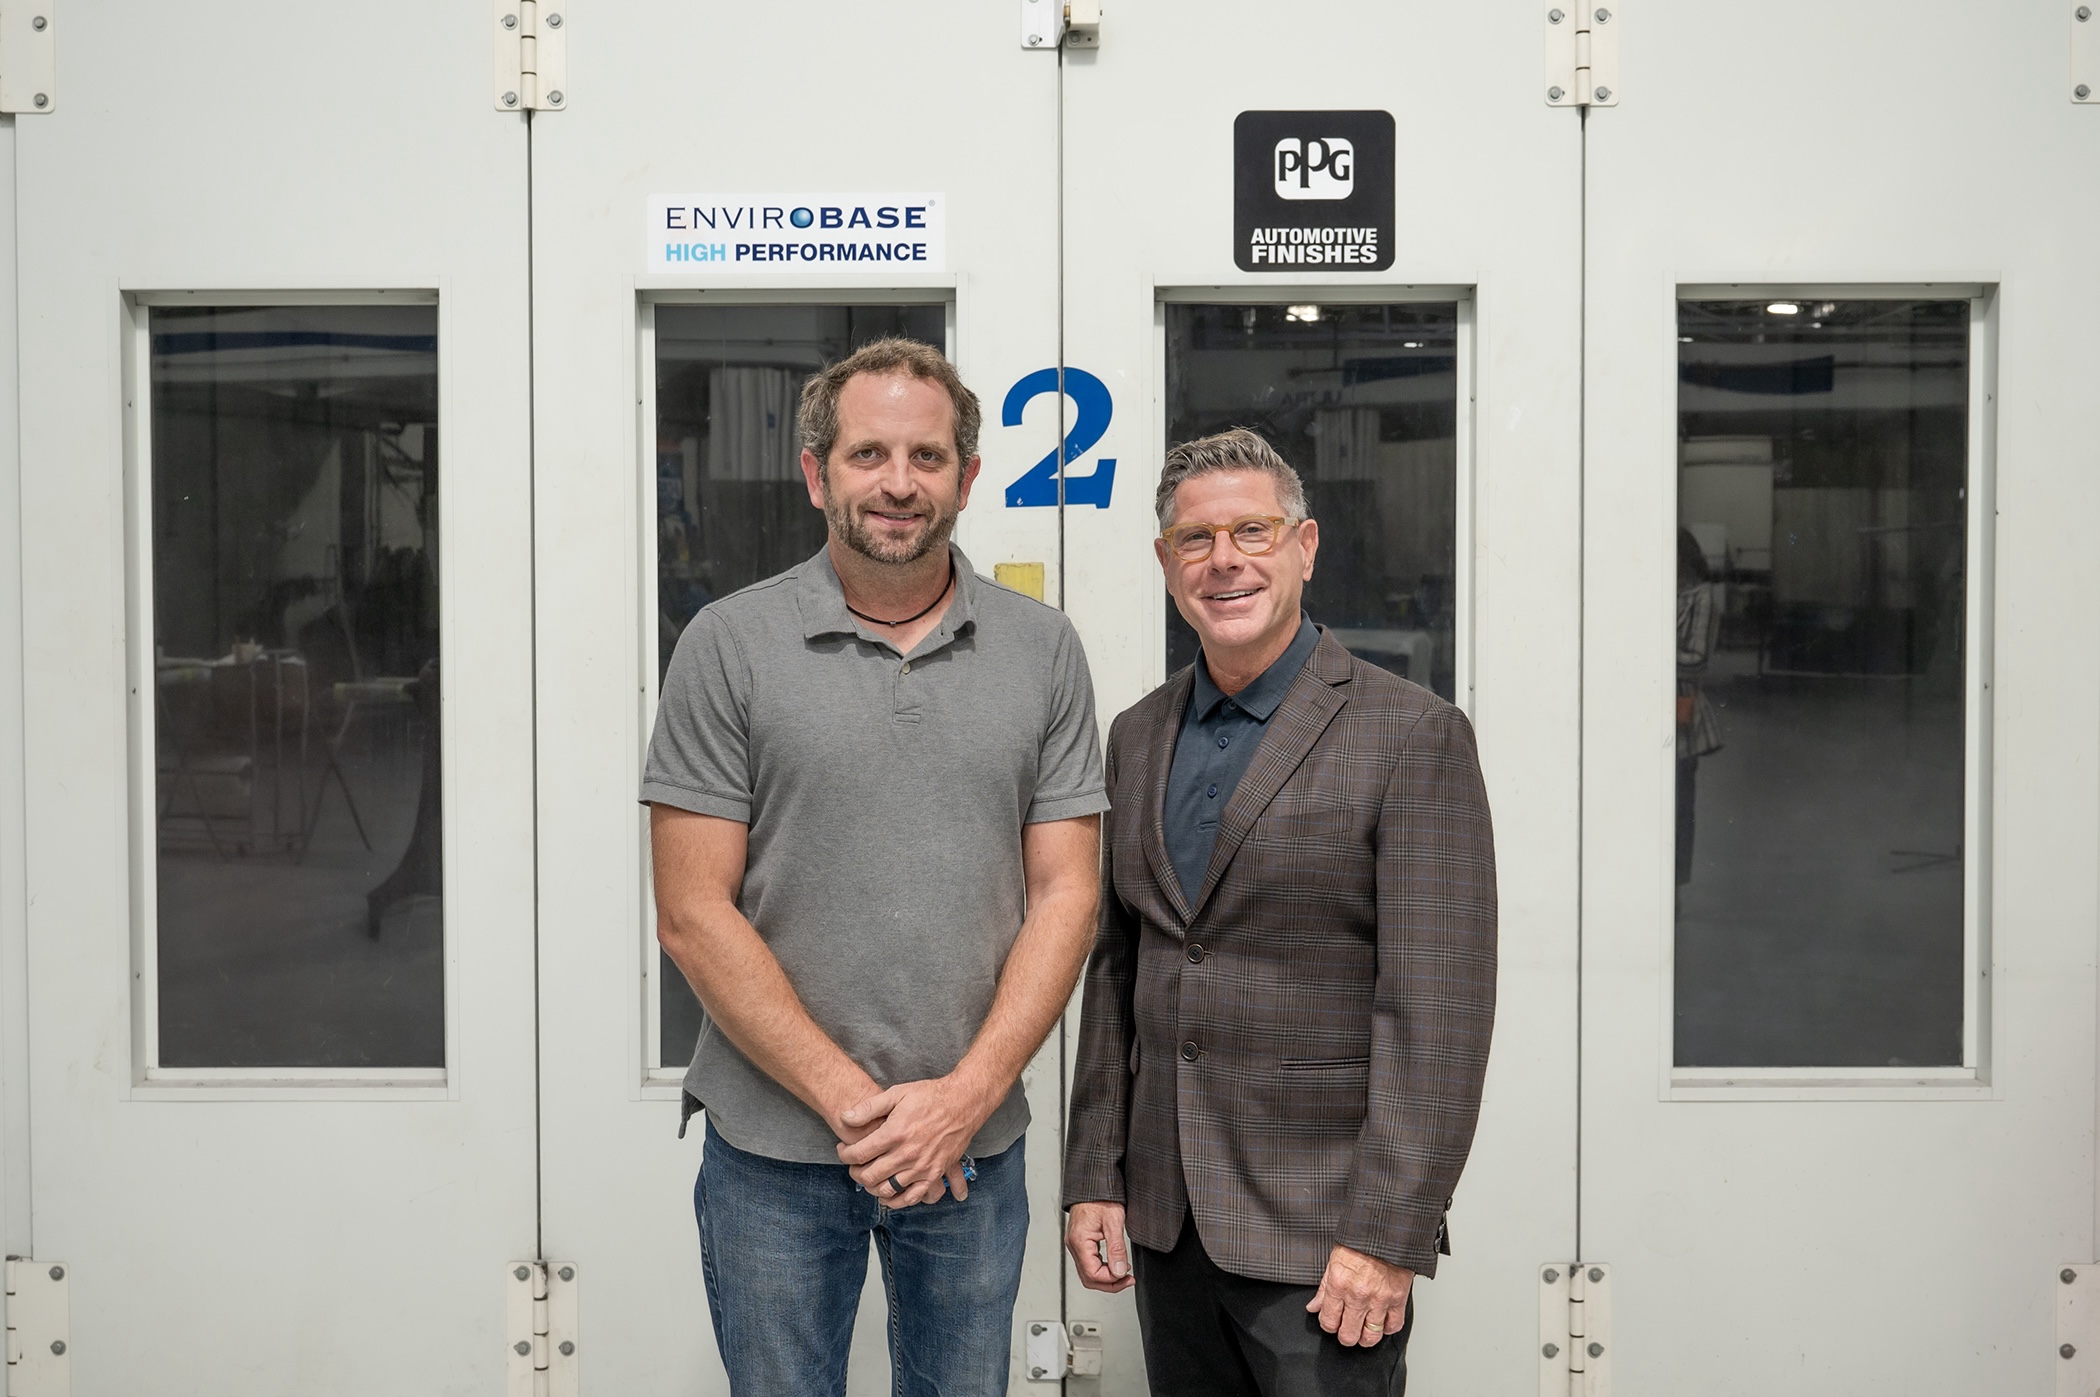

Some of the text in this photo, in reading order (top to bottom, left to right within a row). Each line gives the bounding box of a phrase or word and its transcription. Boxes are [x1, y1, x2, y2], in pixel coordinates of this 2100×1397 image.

[1278, 137, 1350, 189] PPG
[1250, 227, 1378, 245] AUTOMOTIVE
[665, 242, 927, 262] HIGH PERFORMANCE
[1251, 245, 1378, 264] FINISHES
[1001, 366, 1117, 509] 2
